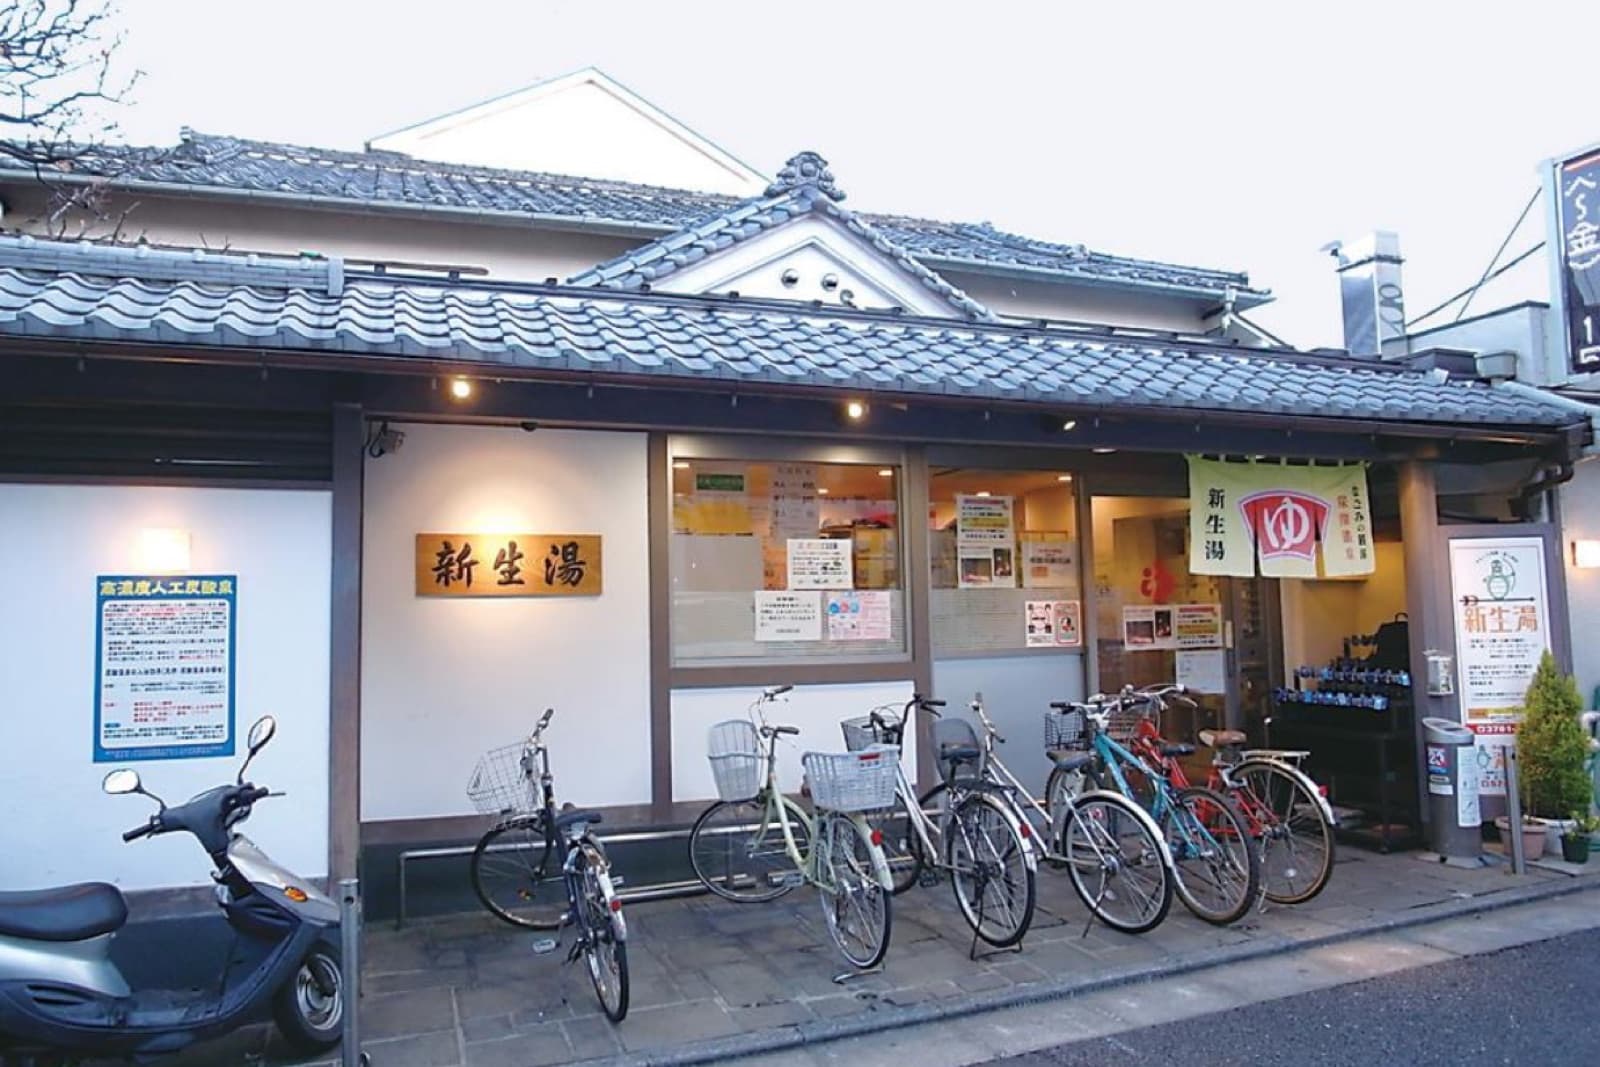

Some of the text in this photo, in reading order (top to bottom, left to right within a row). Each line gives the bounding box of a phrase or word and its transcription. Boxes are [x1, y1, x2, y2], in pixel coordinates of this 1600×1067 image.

[1204, 487, 1226, 562] 新生湯
[1263, 496, 1310, 551] ゆ
[432, 540, 587, 588] 新生湯
[1464, 605, 1538, 633] 新生湯
